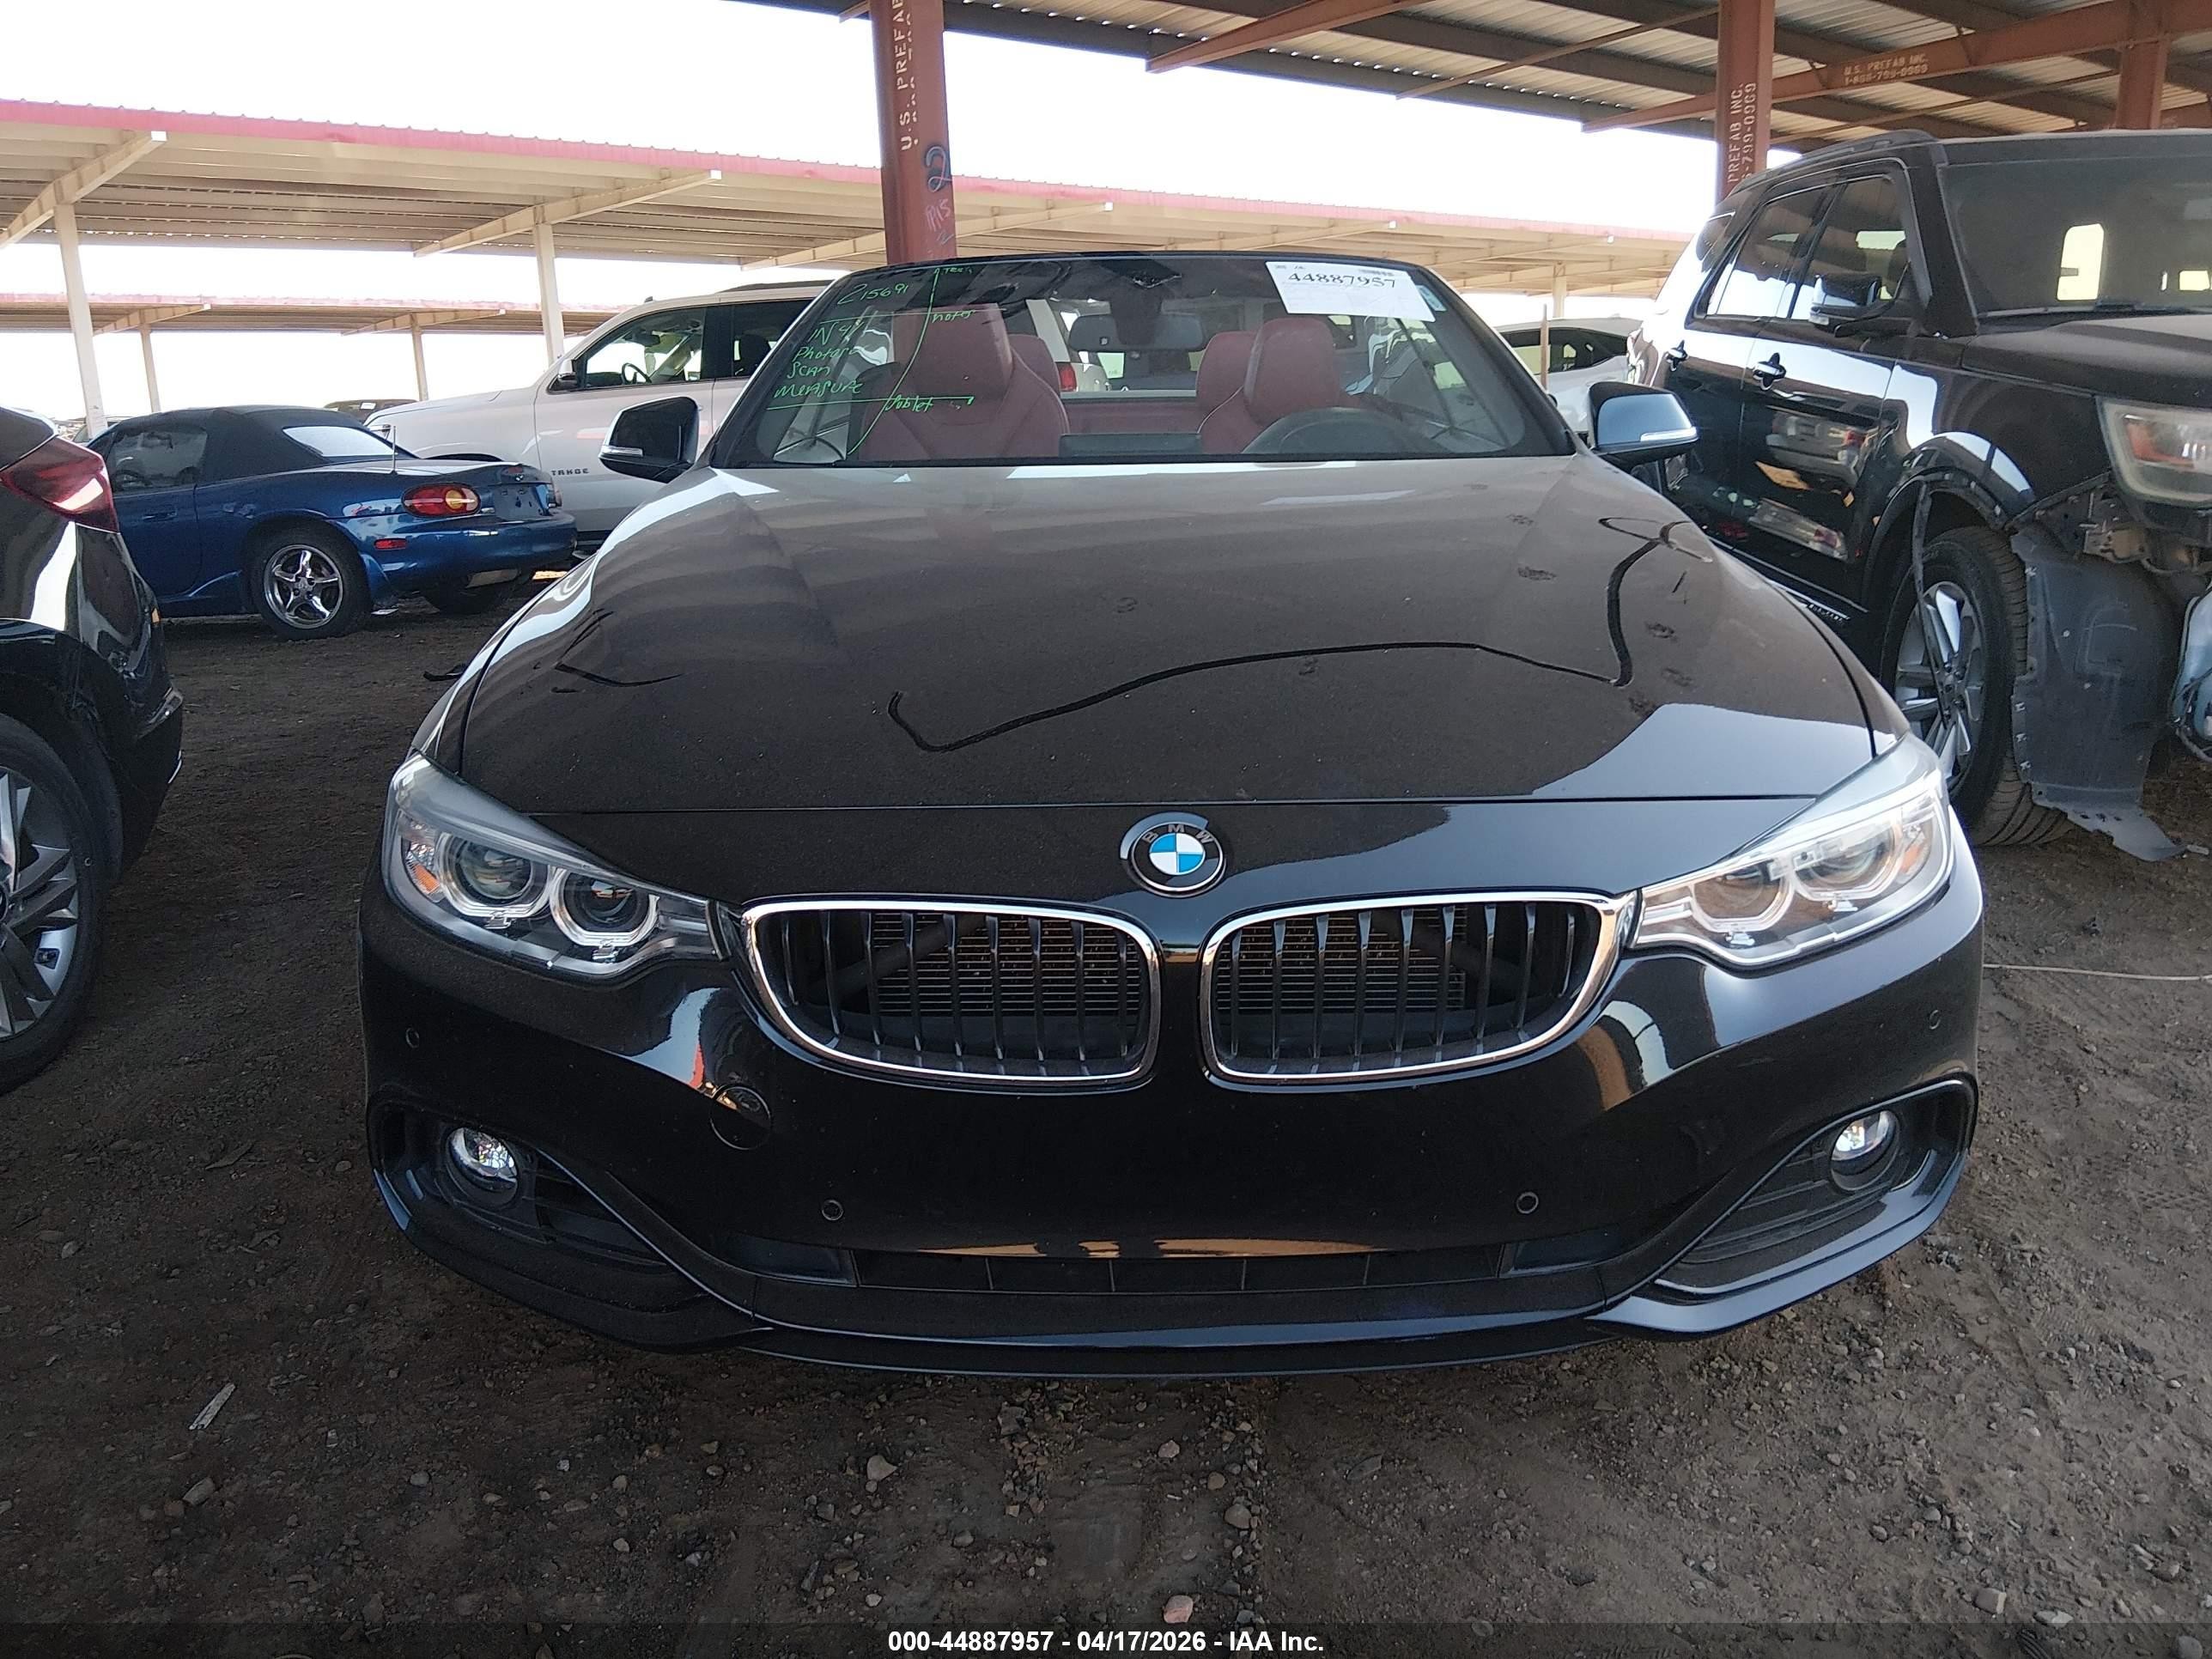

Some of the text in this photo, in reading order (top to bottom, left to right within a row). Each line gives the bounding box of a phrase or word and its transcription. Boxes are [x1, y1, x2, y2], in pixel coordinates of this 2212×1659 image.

[1868, 57, 1905, 71] PREFAB
[1727, 83, 1744, 183] PREFAB INC.
[1289, 272, 1395, 289] 44887957
[1141, 823, 1214, 844] BMW
